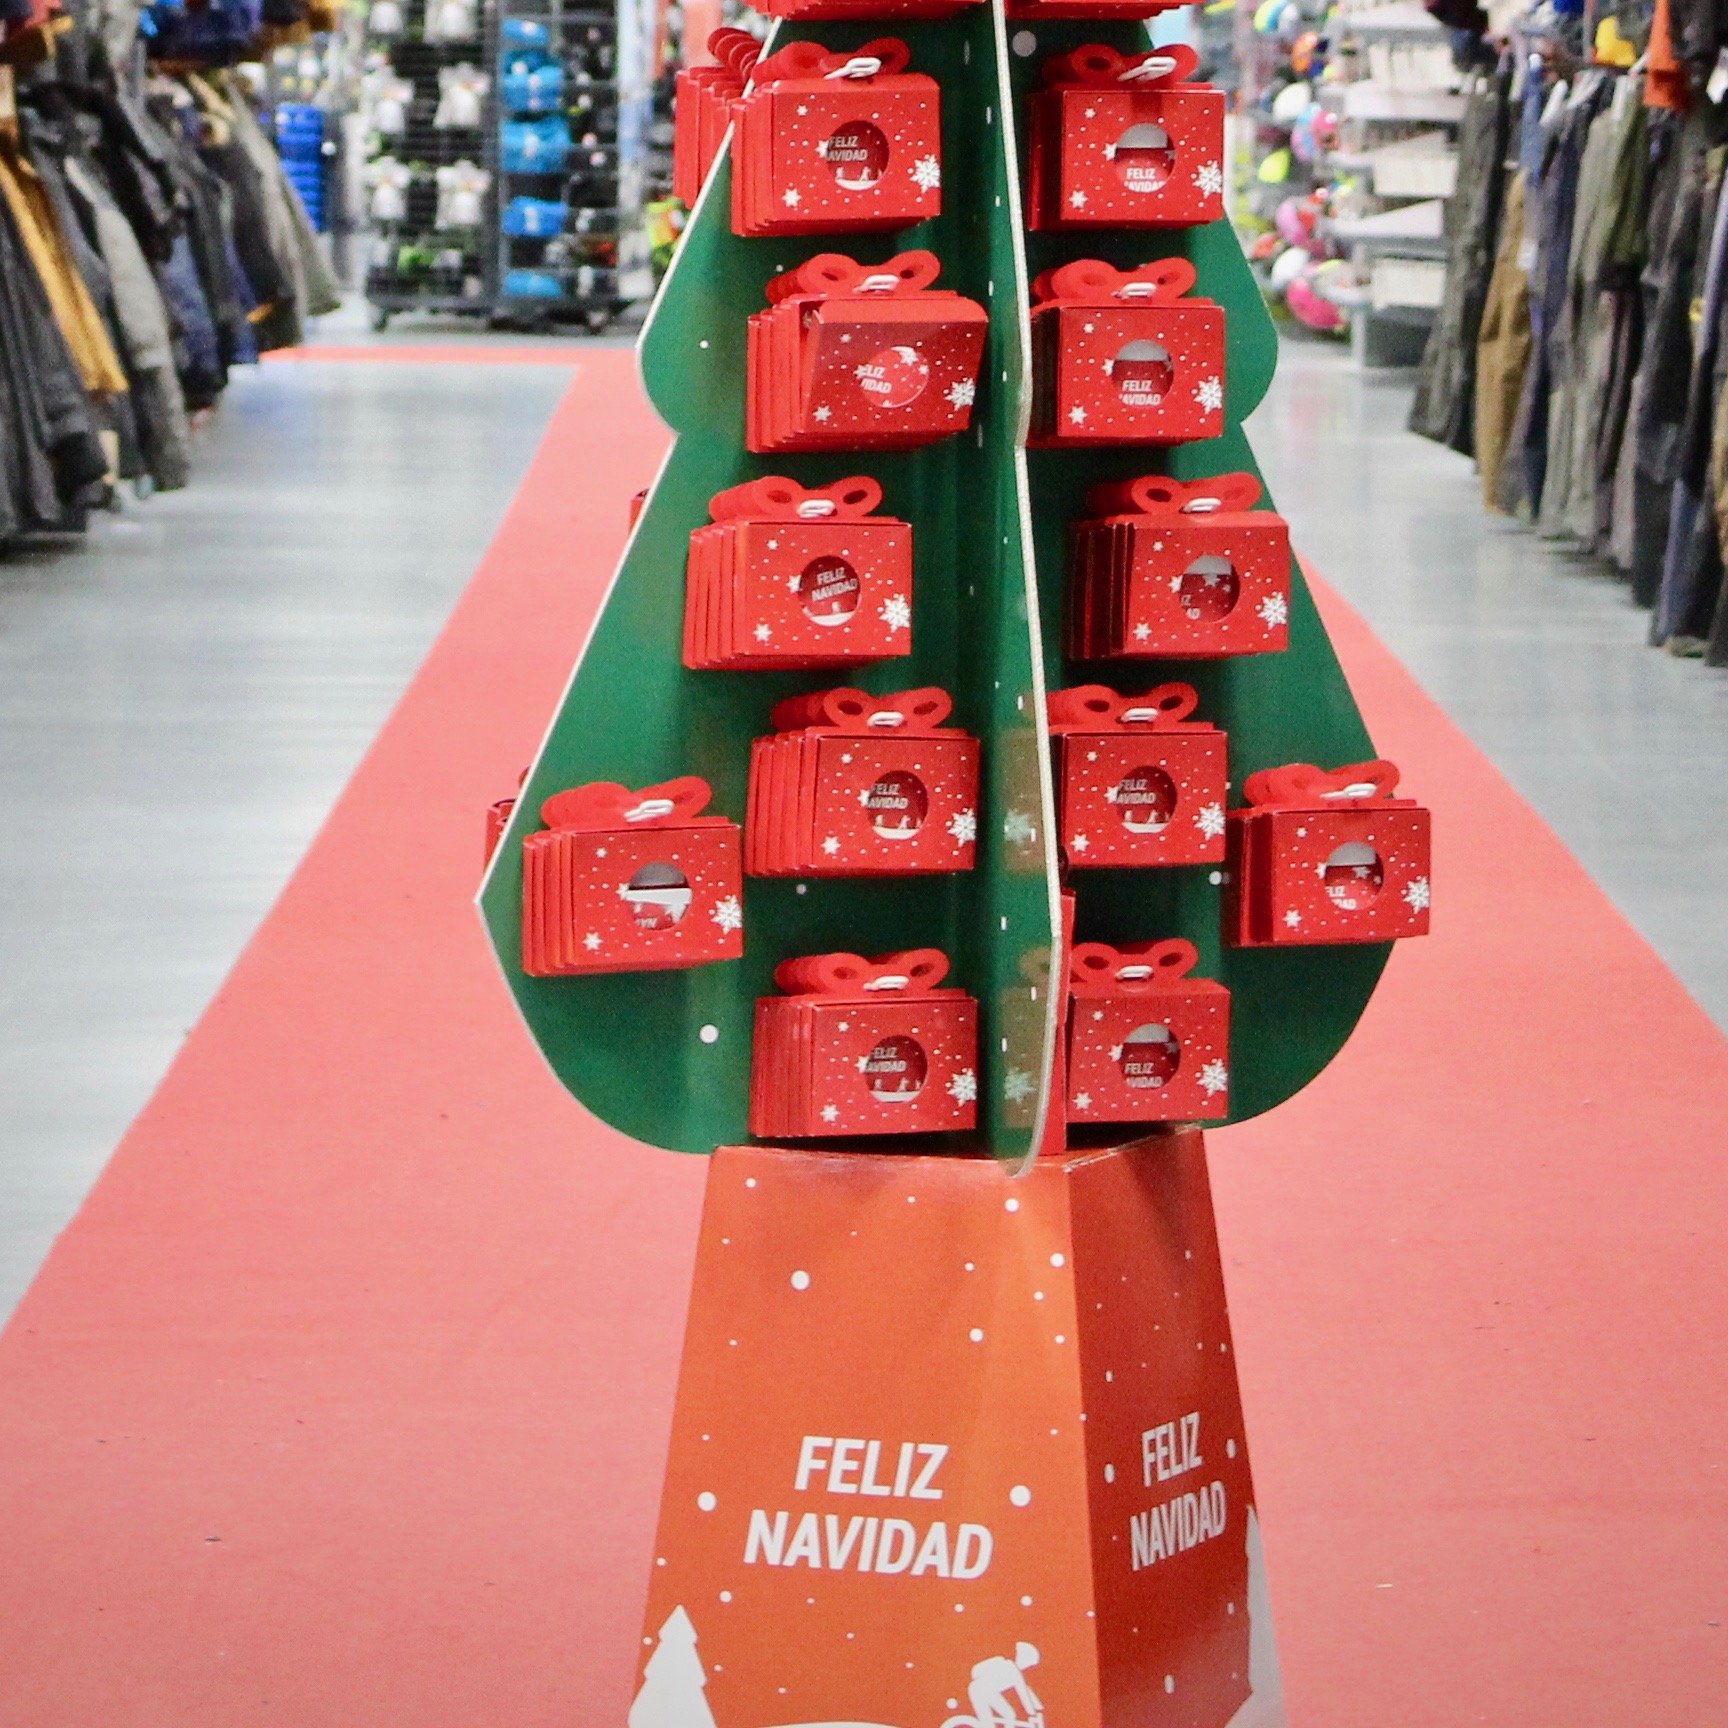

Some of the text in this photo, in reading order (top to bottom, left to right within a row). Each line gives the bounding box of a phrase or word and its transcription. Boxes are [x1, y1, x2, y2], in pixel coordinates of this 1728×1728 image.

[1127, 167, 1156, 180] FELIZ
[1122, 379, 1153, 393] FELIZ
[816, 567, 846, 585] FELIZ
[812, 578, 858, 602] NAVIDAD
[1124, 1062, 1153, 1074] FELIZ
[1141, 1411, 1203, 1487] FELIZ
[794, 1435, 949, 1501] FELIZ
[1129, 1480, 1227, 1572] NAVIDAD
[743, 1509, 994, 1580] NAVIDAD
